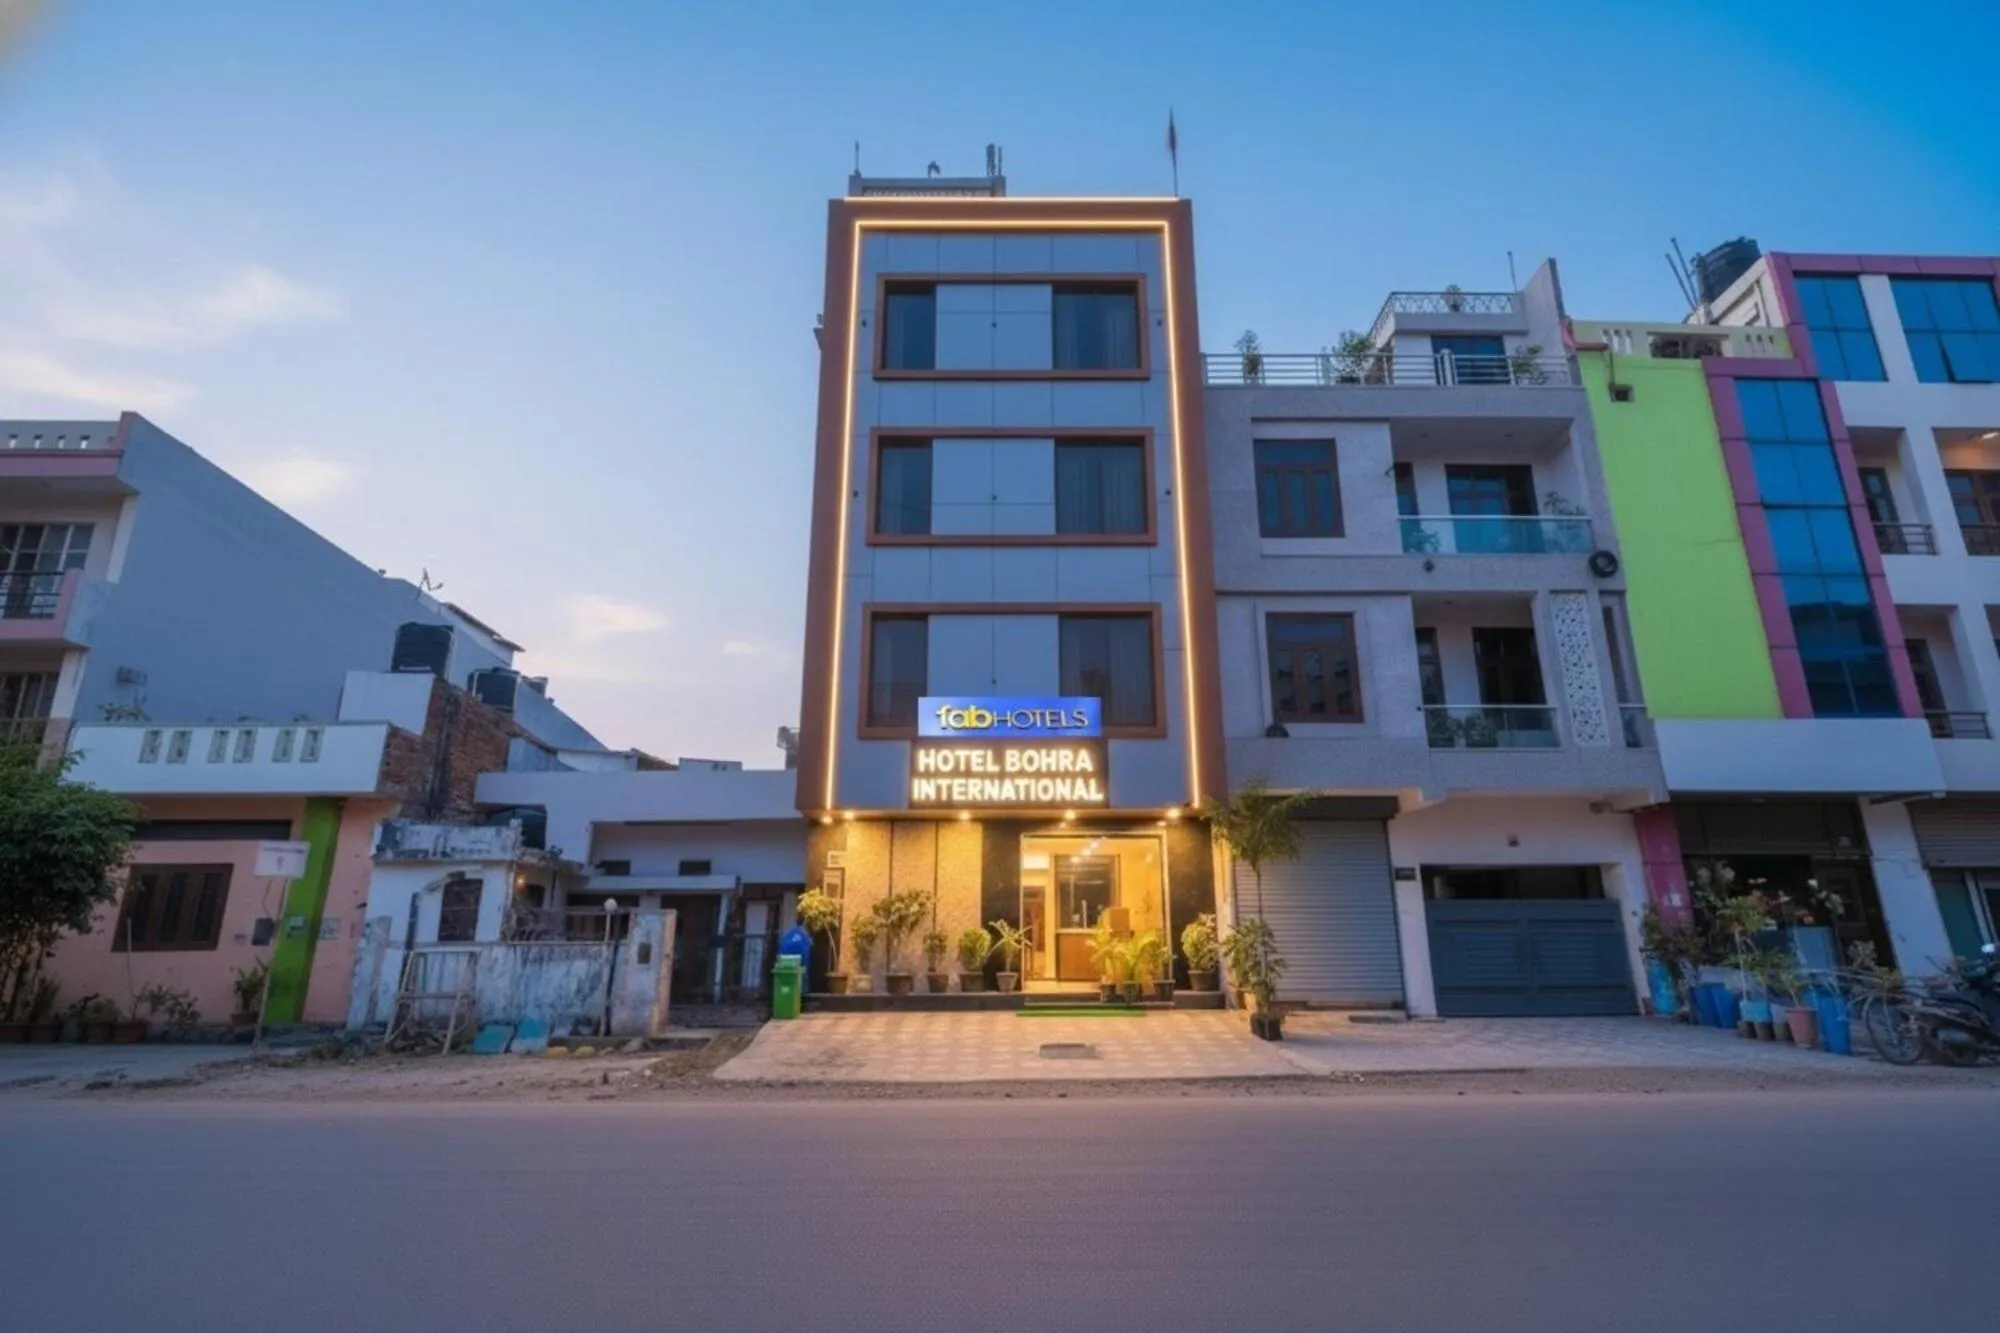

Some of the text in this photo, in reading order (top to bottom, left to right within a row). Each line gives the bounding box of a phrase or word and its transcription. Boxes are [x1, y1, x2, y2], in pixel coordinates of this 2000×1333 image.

[918, 748, 1094, 772] HOTEL BOHRA
[913, 777, 1104, 801] INTERNATIONAL
